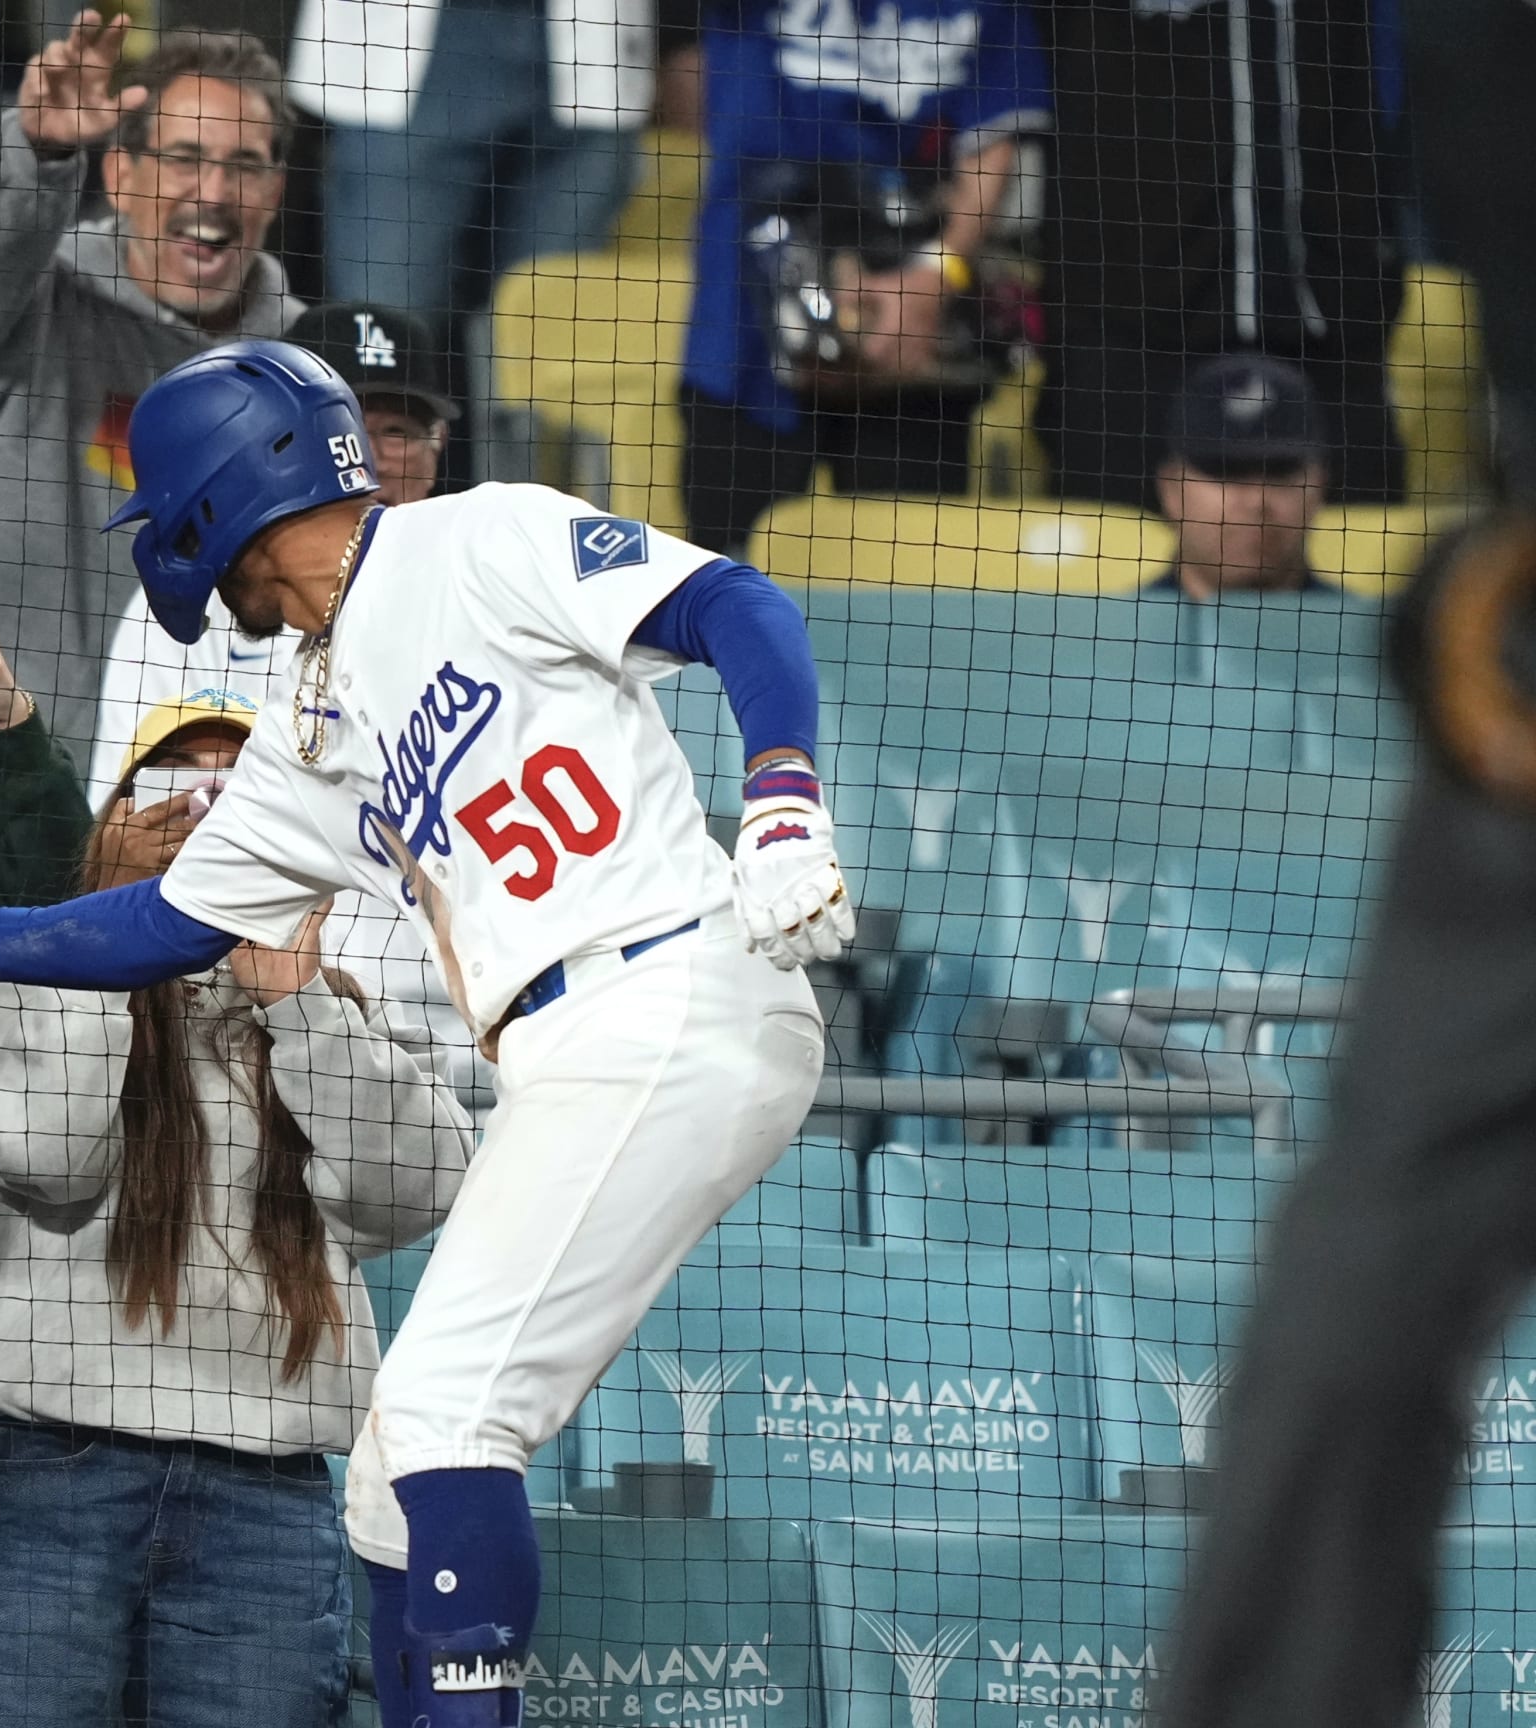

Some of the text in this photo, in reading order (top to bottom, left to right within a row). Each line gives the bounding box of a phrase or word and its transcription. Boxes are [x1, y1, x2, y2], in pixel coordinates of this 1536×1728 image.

[353, 313, 396, 367] LA
[328, 432, 364, 468] 50
[359, 661, 501, 907] Ddgers
[454, 744, 621, 901] 50
[756, 1416, 1050, 1444] RESORT & CASINO
[783, 1449, 1024, 1474] AT SAN MANUEL
[989, 1639, 1160, 1681] YAAM
[525, 1683, 784, 1718] SORT & CASINO
[987, 1682, 1119, 1710] RESORT
[1500, 1690, 1536, 1712] RE
